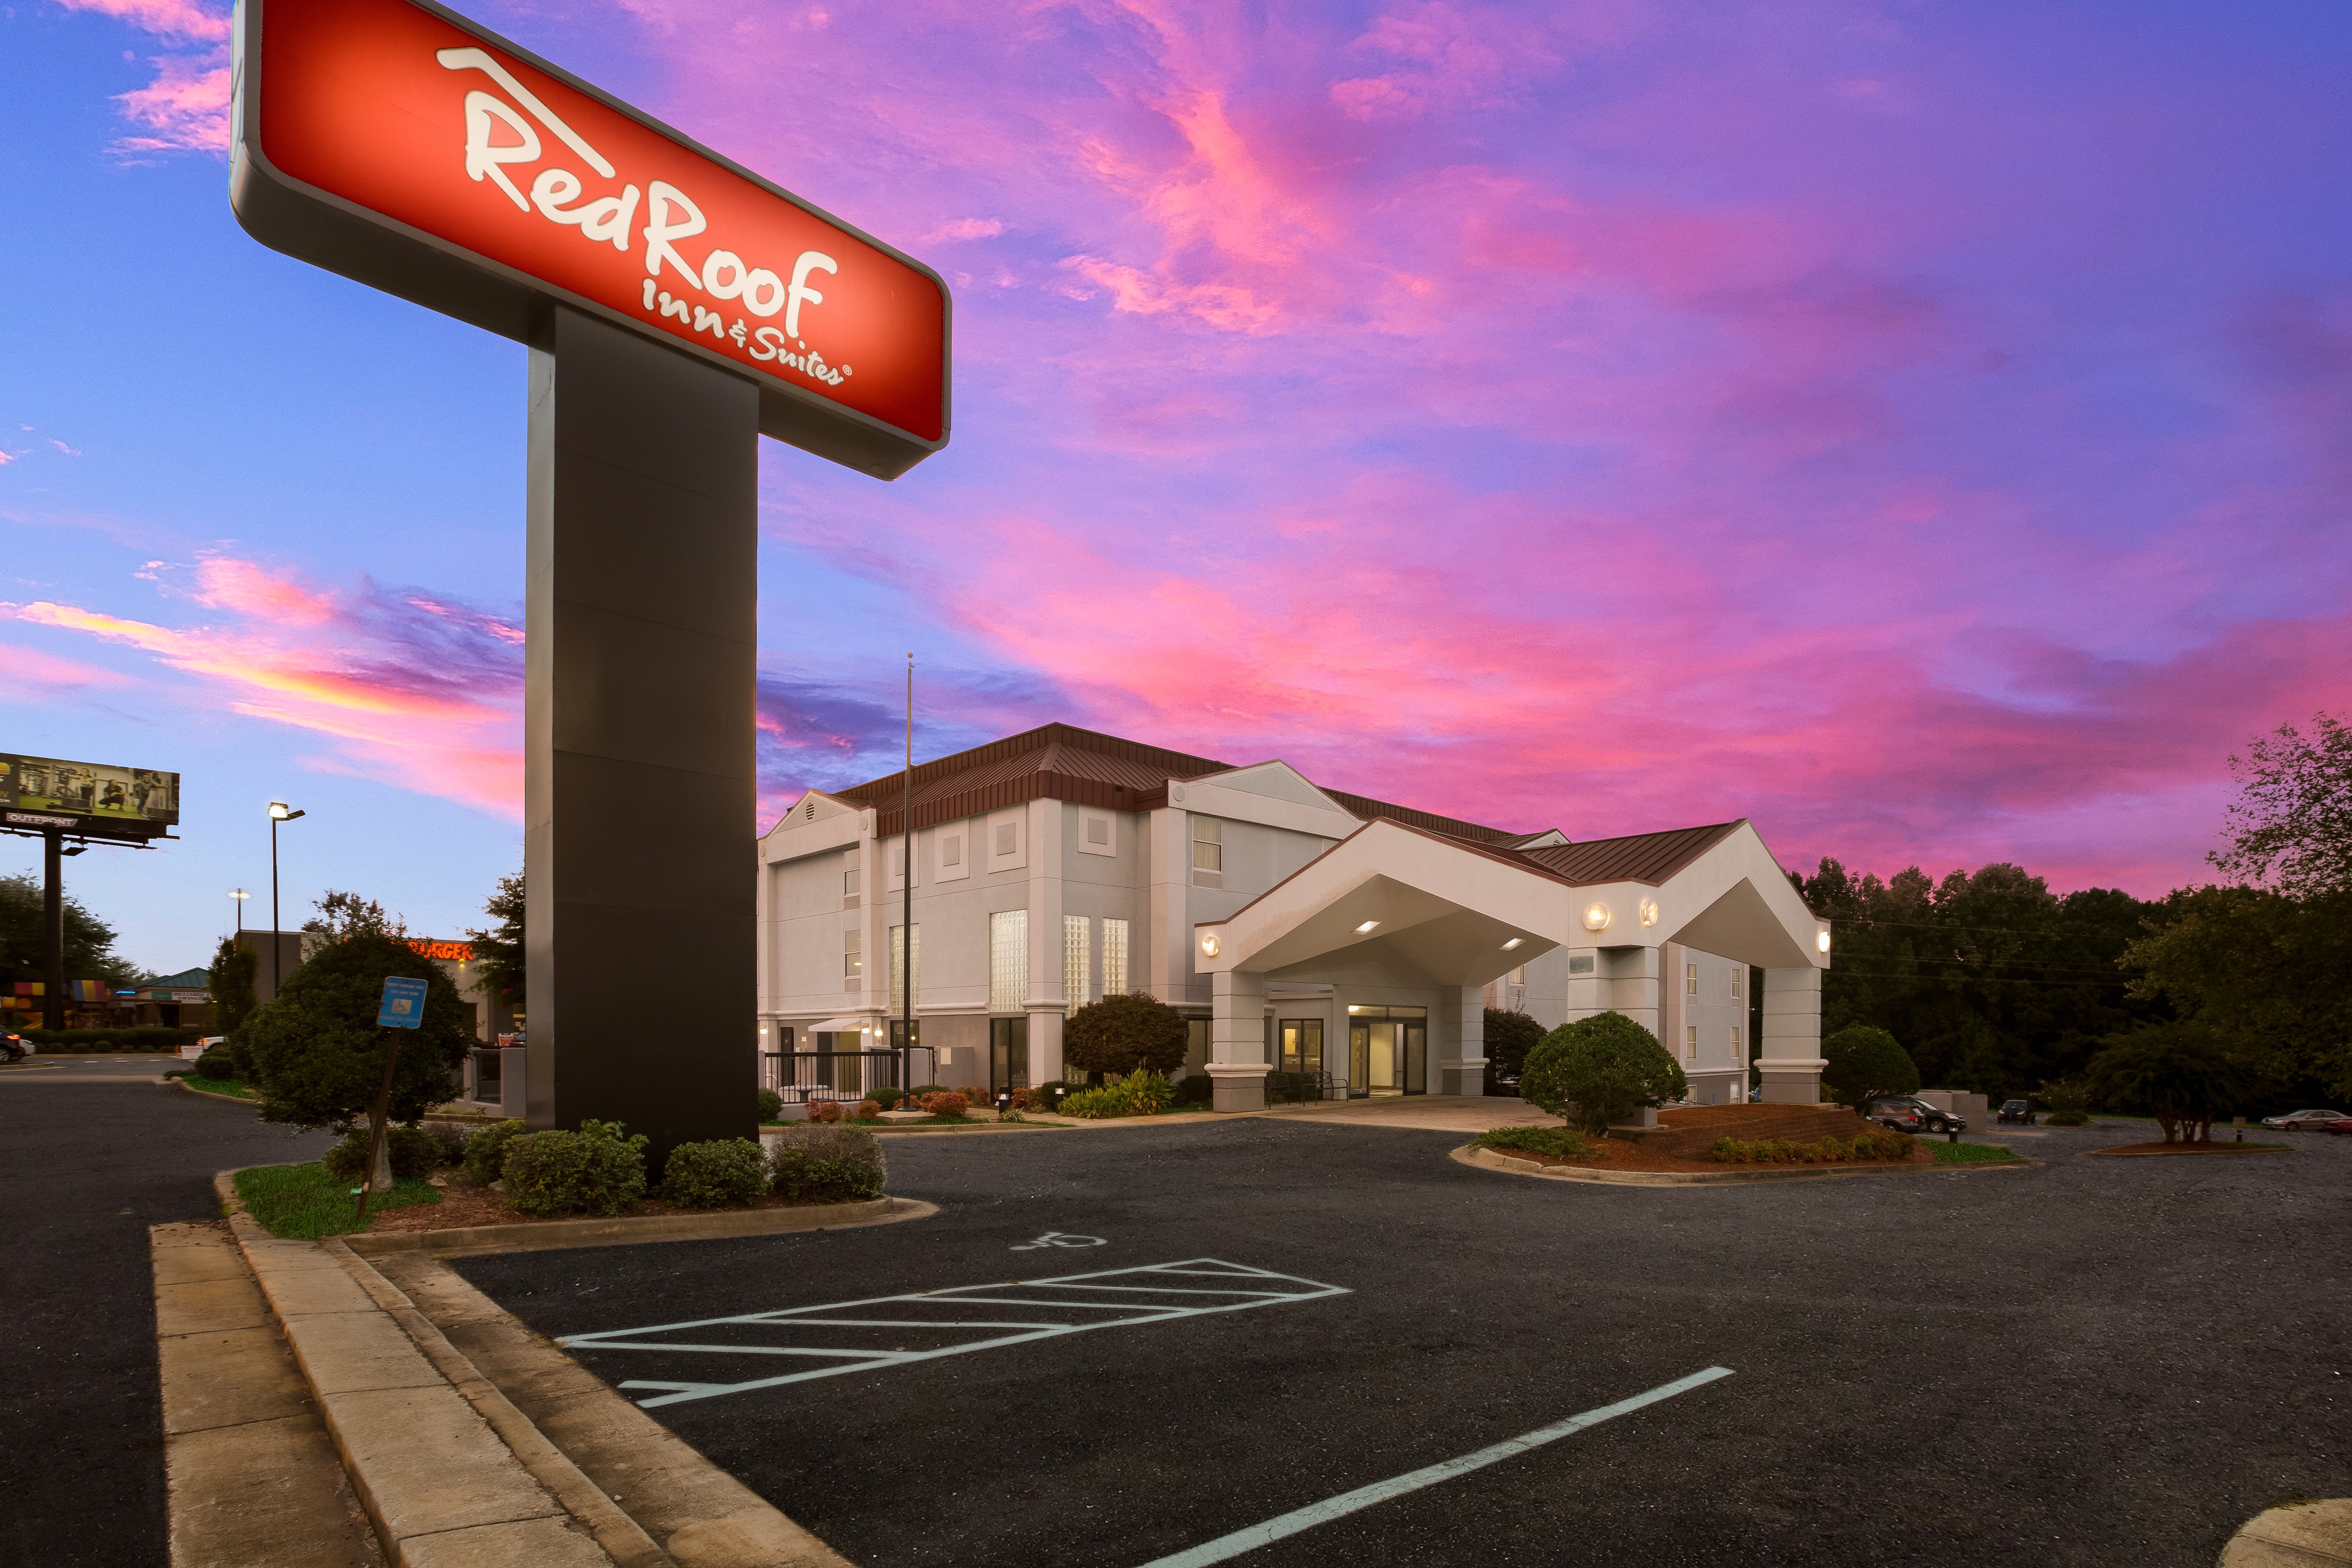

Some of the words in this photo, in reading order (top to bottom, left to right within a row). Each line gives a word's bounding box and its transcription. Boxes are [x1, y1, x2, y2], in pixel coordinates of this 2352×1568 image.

[465, 90, 640, 252] Red
[643, 180, 838, 339] Roof
[642, 278, 726, 339] Inn
[728, 318, 748, 348] &
[9, 814, 74, 825] OUTFRONT
